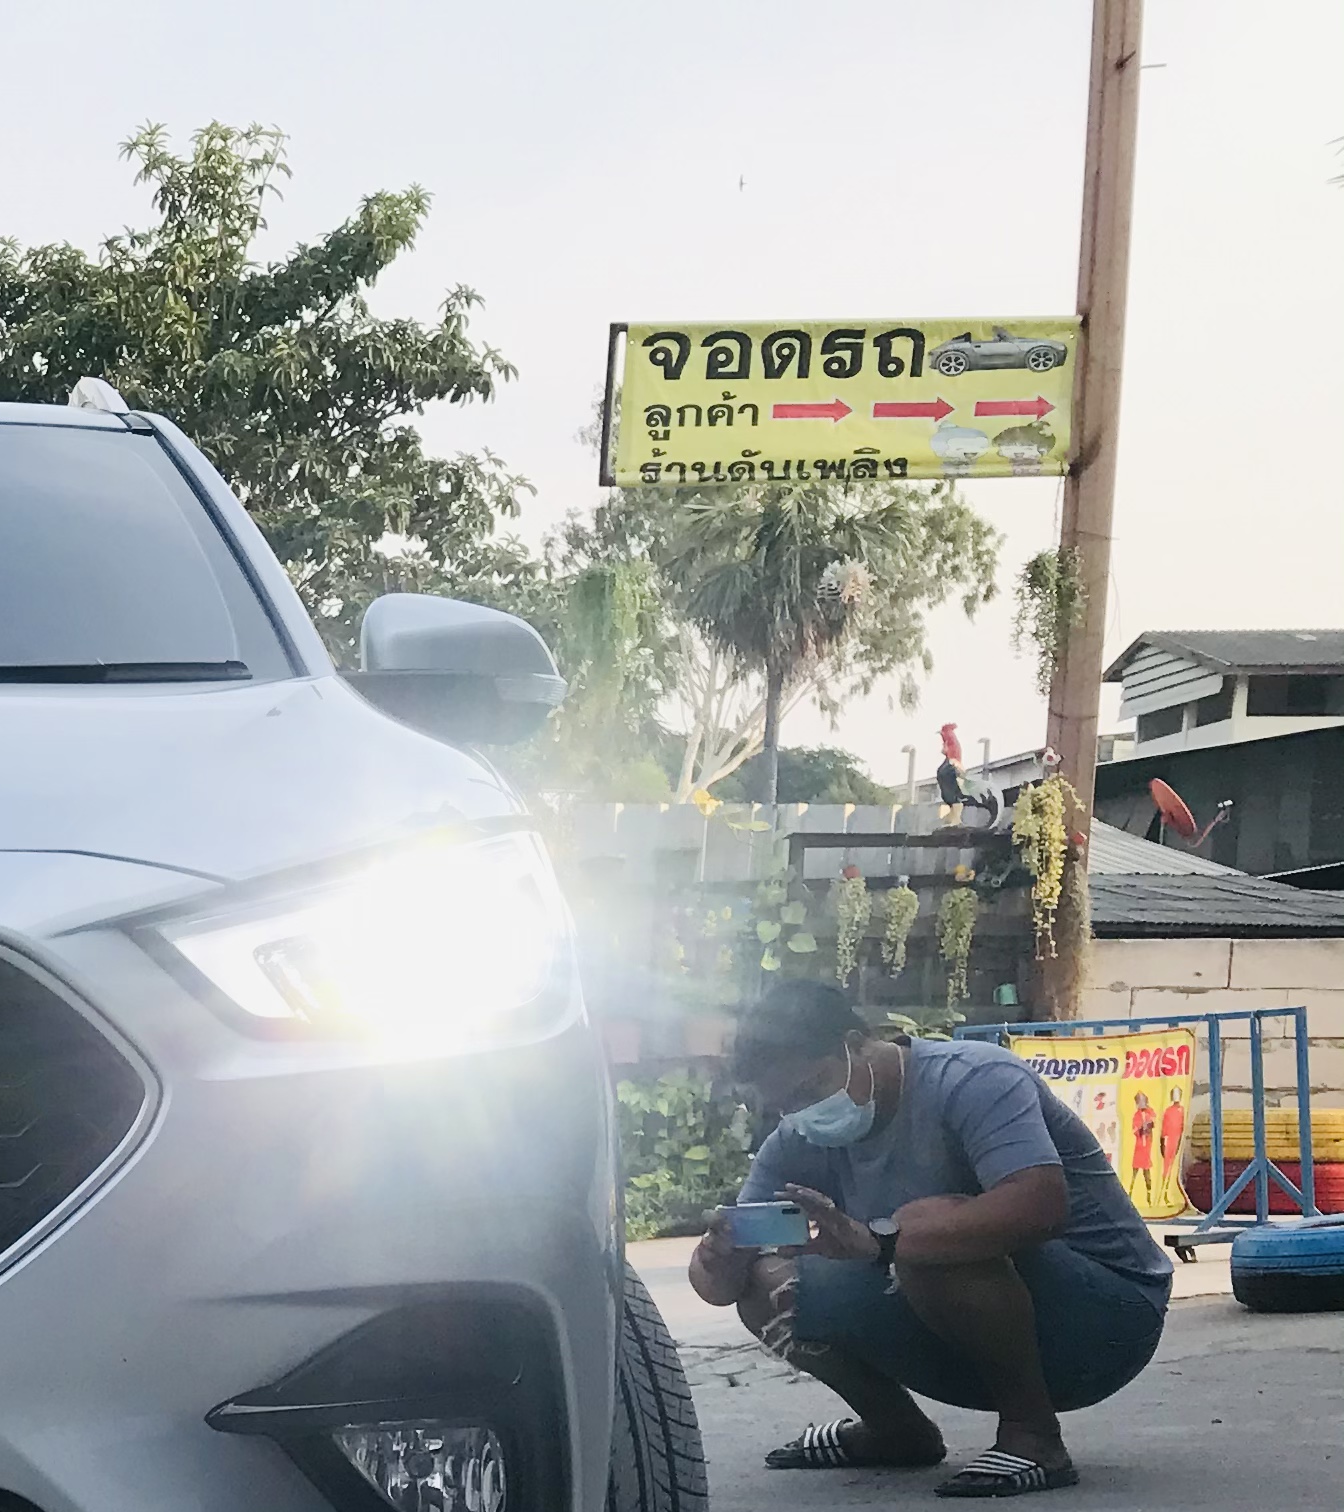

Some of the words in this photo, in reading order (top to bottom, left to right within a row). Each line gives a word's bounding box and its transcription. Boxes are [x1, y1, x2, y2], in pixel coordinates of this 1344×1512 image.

[641, 327, 926, 380] จอดรถ
[644, 391, 759, 441] ลูกค้า
[639, 447, 909, 483] ร้านดับเพลิง
